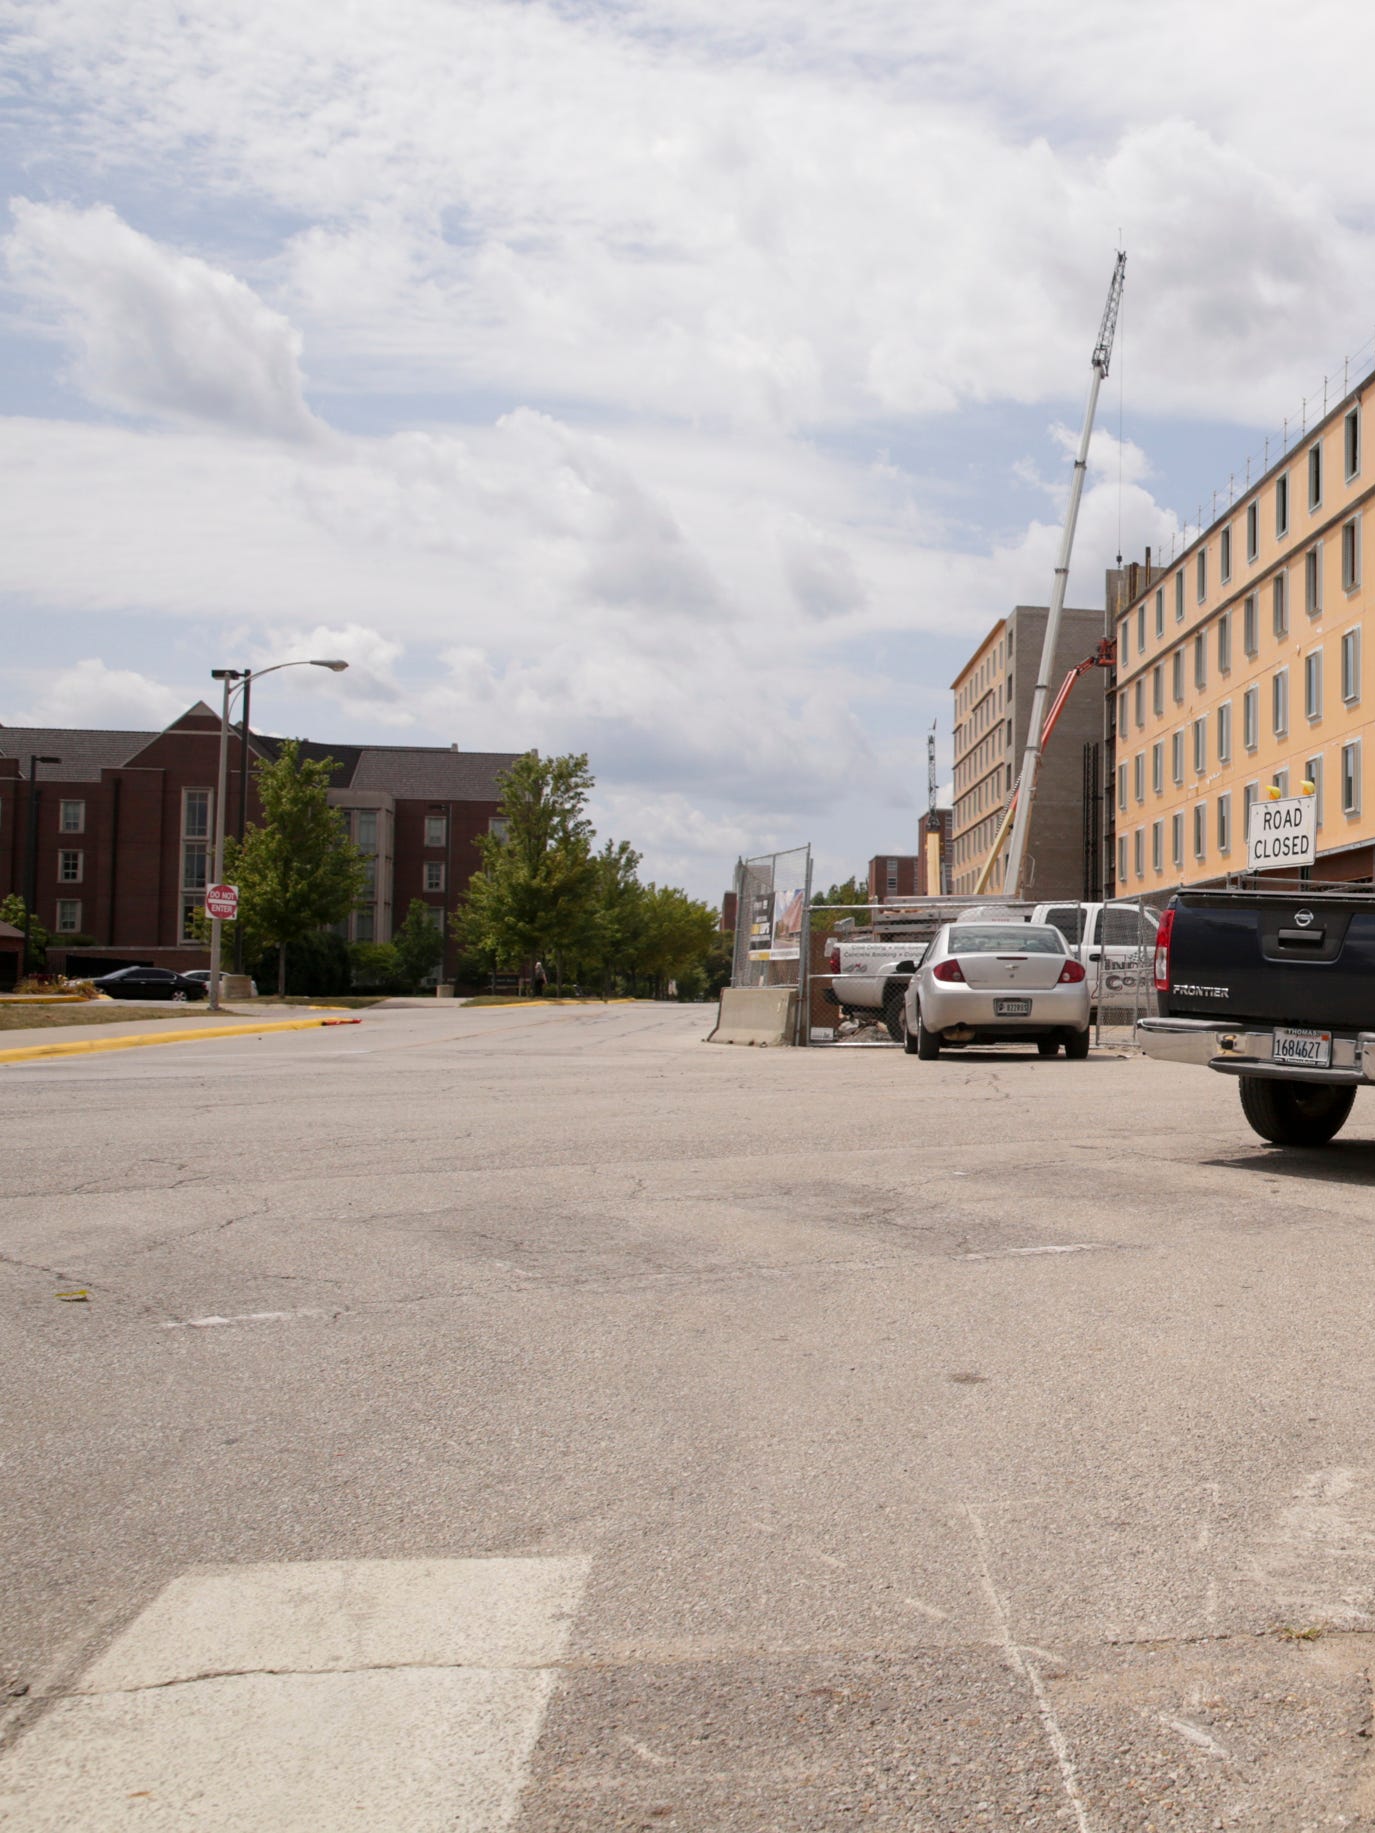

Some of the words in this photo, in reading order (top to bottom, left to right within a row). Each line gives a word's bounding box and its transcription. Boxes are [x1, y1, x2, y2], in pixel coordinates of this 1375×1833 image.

[1263, 808, 1303, 831] ROAD
[1254, 835, 1309, 859] CLOSED
[210, 890, 220, 899] DO
[222, 891, 234, 900] NOT
[211, 904, 232, 912] ENTER
[1173, 984, 1230, 999] FRONTIER
[1274, 1039, 1321, 1060] 1684627
